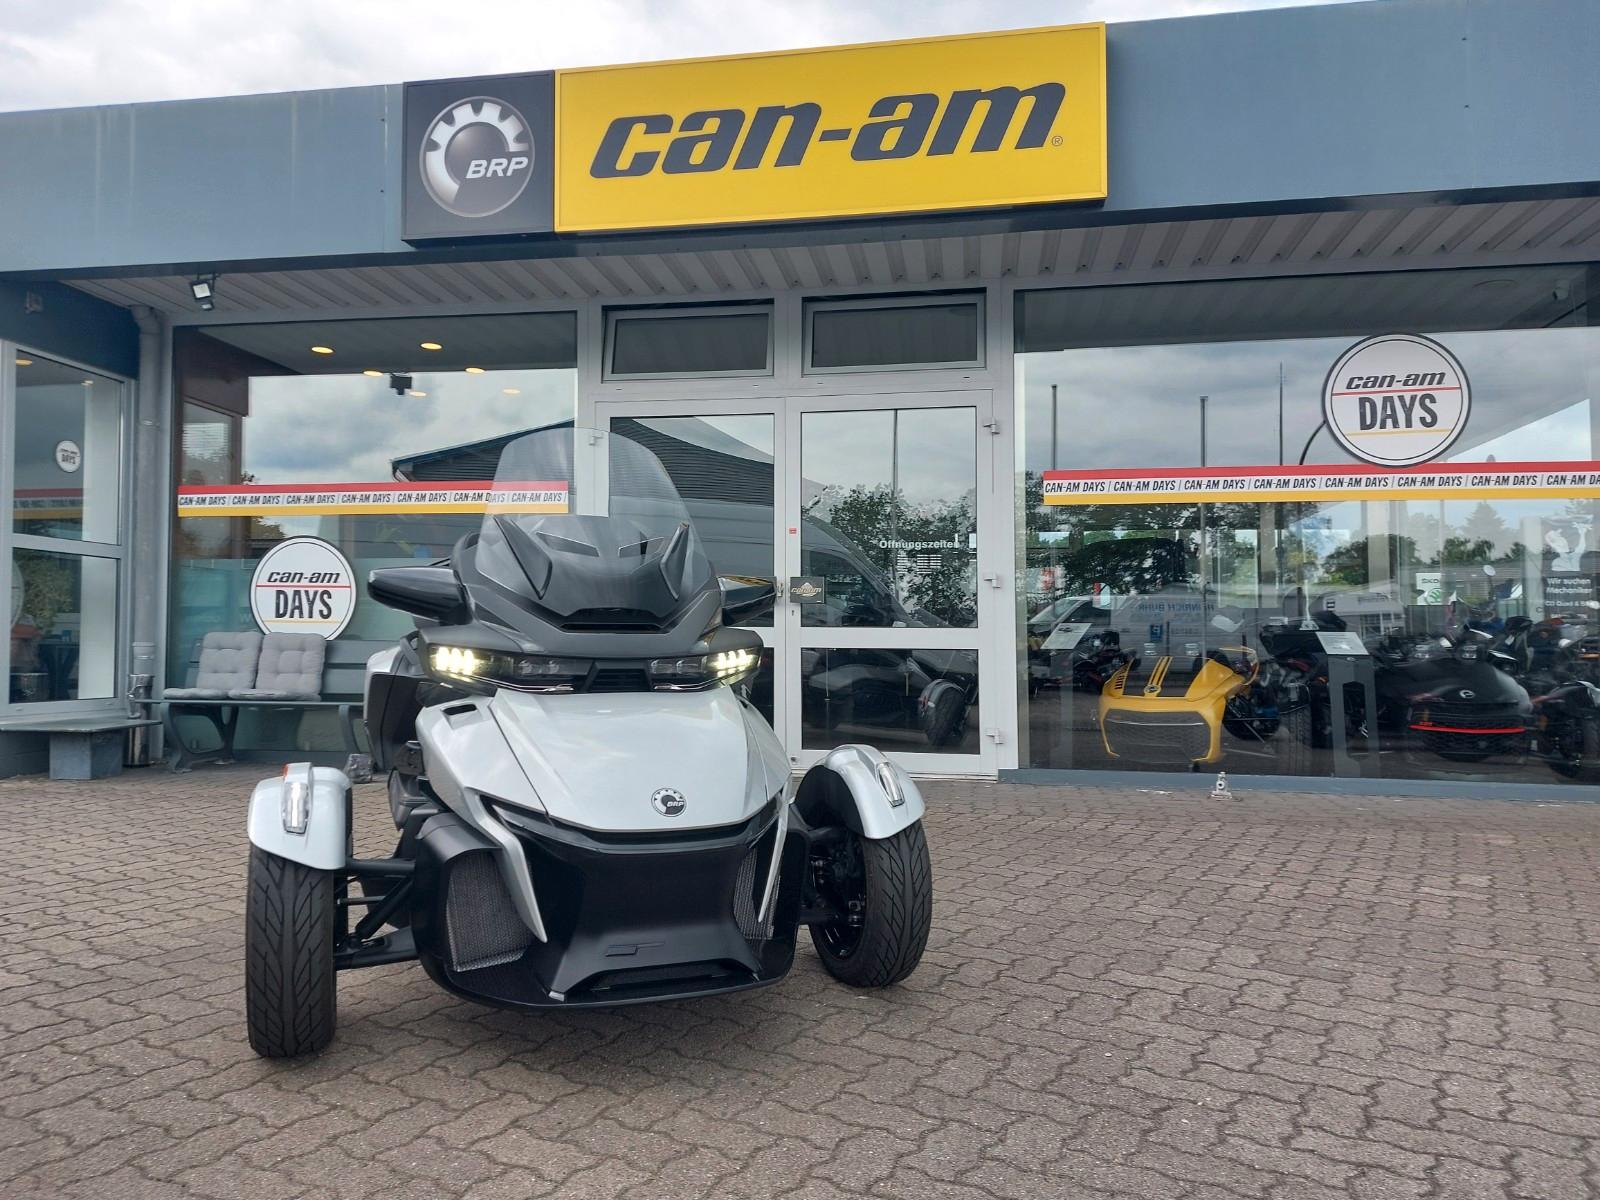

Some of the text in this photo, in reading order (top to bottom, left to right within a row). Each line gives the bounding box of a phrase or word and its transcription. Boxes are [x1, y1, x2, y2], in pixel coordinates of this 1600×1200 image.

[589, 82, 1066, 179] can-am
[465, 157, 529, 179] BRP
[1345, 371, 1446, 390] can-am
[1358, 393, 1438, 431] DAYS
[1045, 474, 1600, 492] CAN-AM DAYS CAN-AM DAYS CAN-AM DAYS CAN-AM DAYS CAN-AM DAYS CAN-AM DAYS CAN-AM DAYS CAN-AM DA
[179, 492, 562, 505] CAN-AM DAYS CAN-AM DAYS CAN-AM DAYS CAN-AM DAYS CAN-AM DAYS CAN-AM DAYS CAN-AM DAYS
[267, 572, 340, 584] can-am
[274, 590, 332, 619] DAYS
